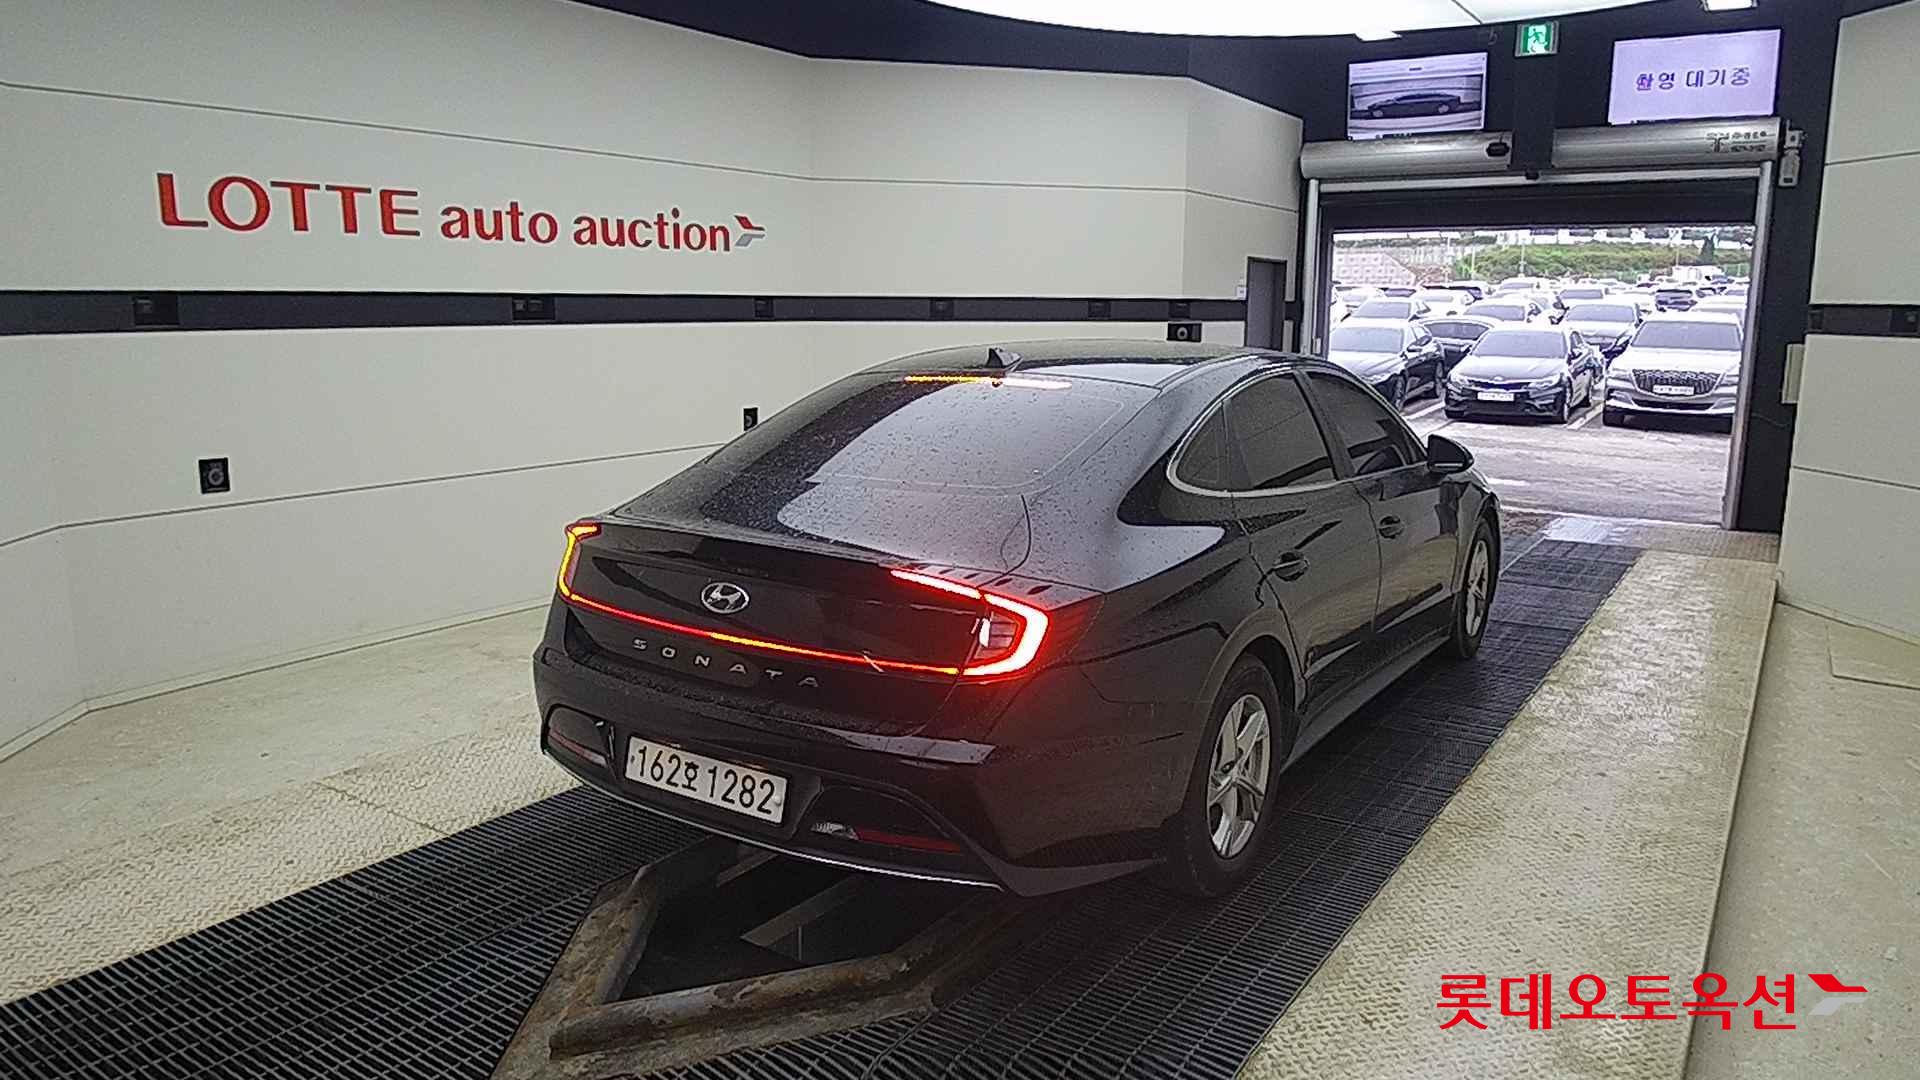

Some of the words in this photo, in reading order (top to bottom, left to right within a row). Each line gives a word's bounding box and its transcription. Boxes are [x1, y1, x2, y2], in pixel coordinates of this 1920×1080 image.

[1636, 71, 1675, 92] 촬영
[1686, 67, 1750, 88] 대기중
[156, 172, 421, 237] LOTTE
[441, 202, 559, 244] auto
[573, 208, 730, 252] auction
[633, 639, 819, 687] SONATA
